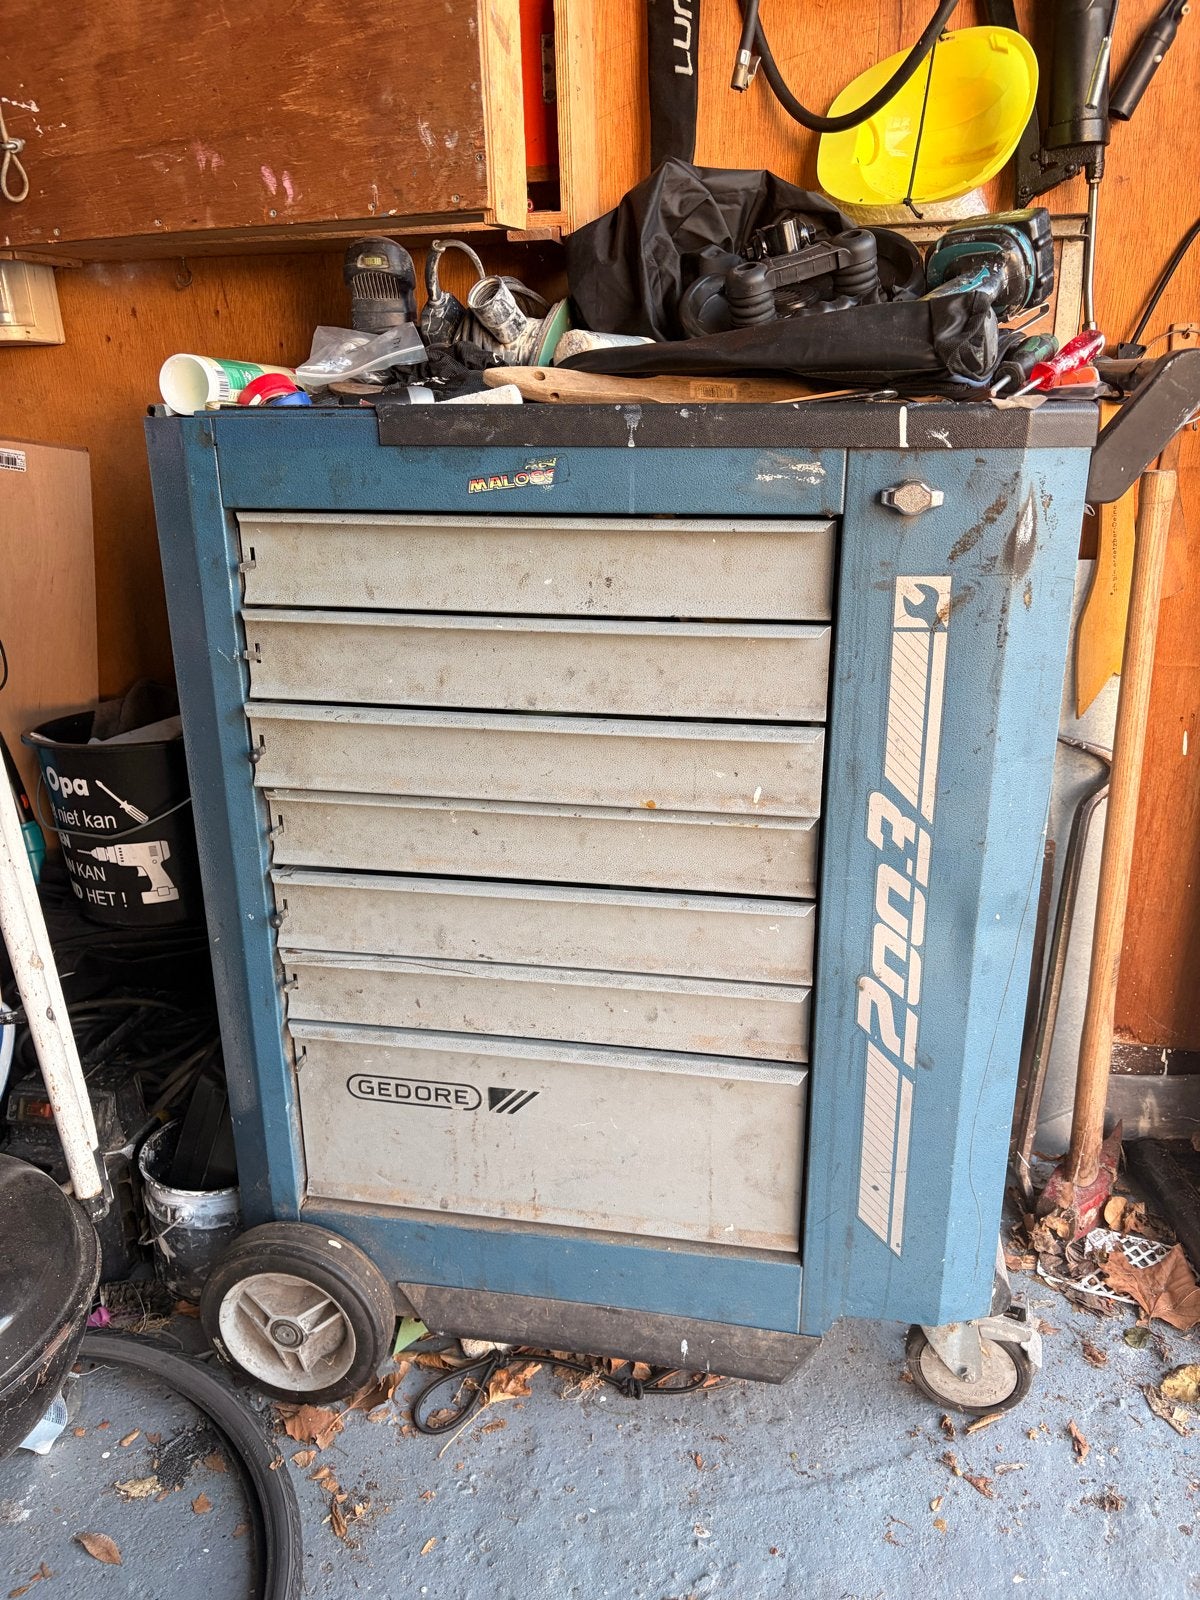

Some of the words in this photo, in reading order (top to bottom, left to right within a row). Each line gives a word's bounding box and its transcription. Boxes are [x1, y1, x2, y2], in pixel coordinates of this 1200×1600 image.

[46, 766, 90, 798] Opa
[57, 806, 80, 826] niet
[82, 810, 117, 829] kan
[76, 862, 106, 882] KAN
[86, 887, 115, 907] HET
[358, 1080, 470, 1105] GEDORE
